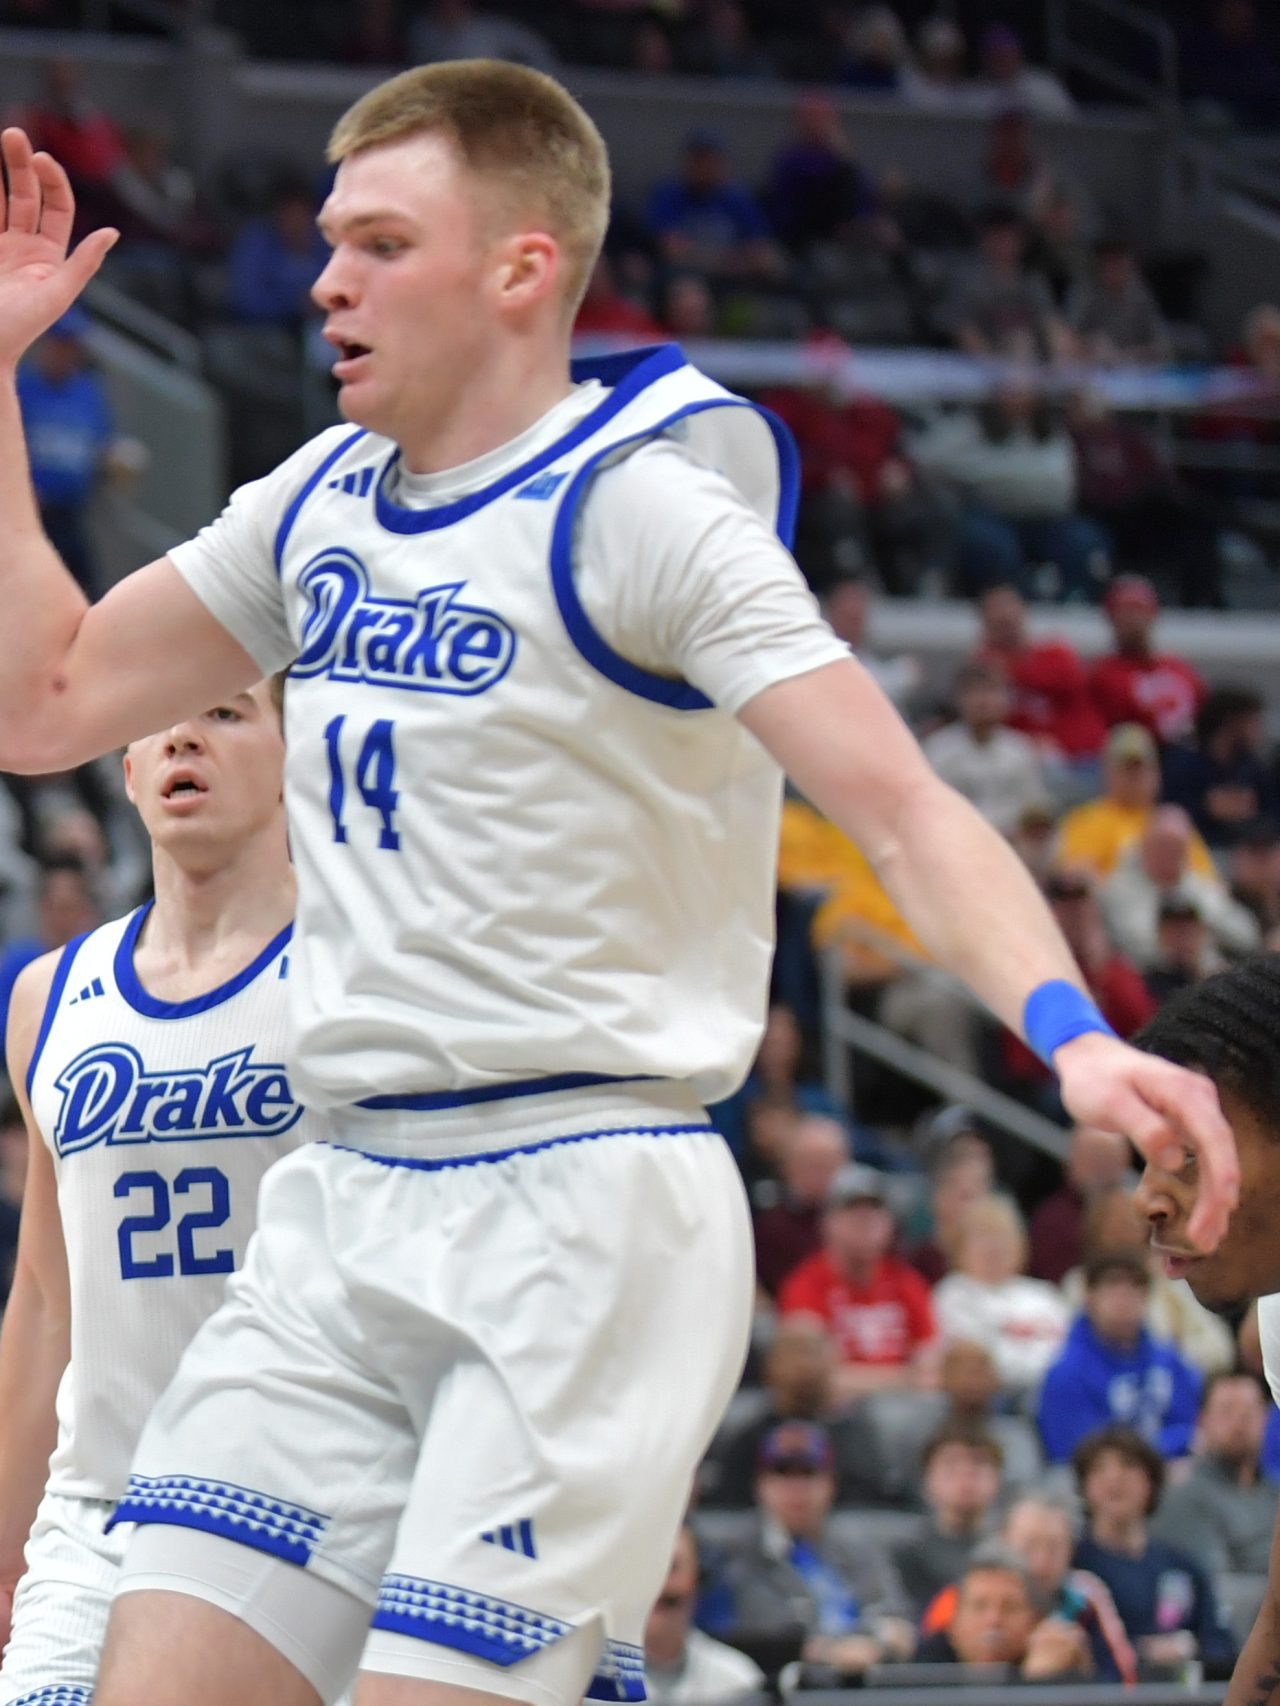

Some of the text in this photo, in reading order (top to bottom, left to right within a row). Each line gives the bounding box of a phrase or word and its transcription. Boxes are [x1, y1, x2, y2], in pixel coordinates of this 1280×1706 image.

[287, 545, 517, 697] Drake
[322, 714, 401, 851] 14
[54, 1041, 305, 1158] Drake
[113, 1166, 235, 1280] 22
